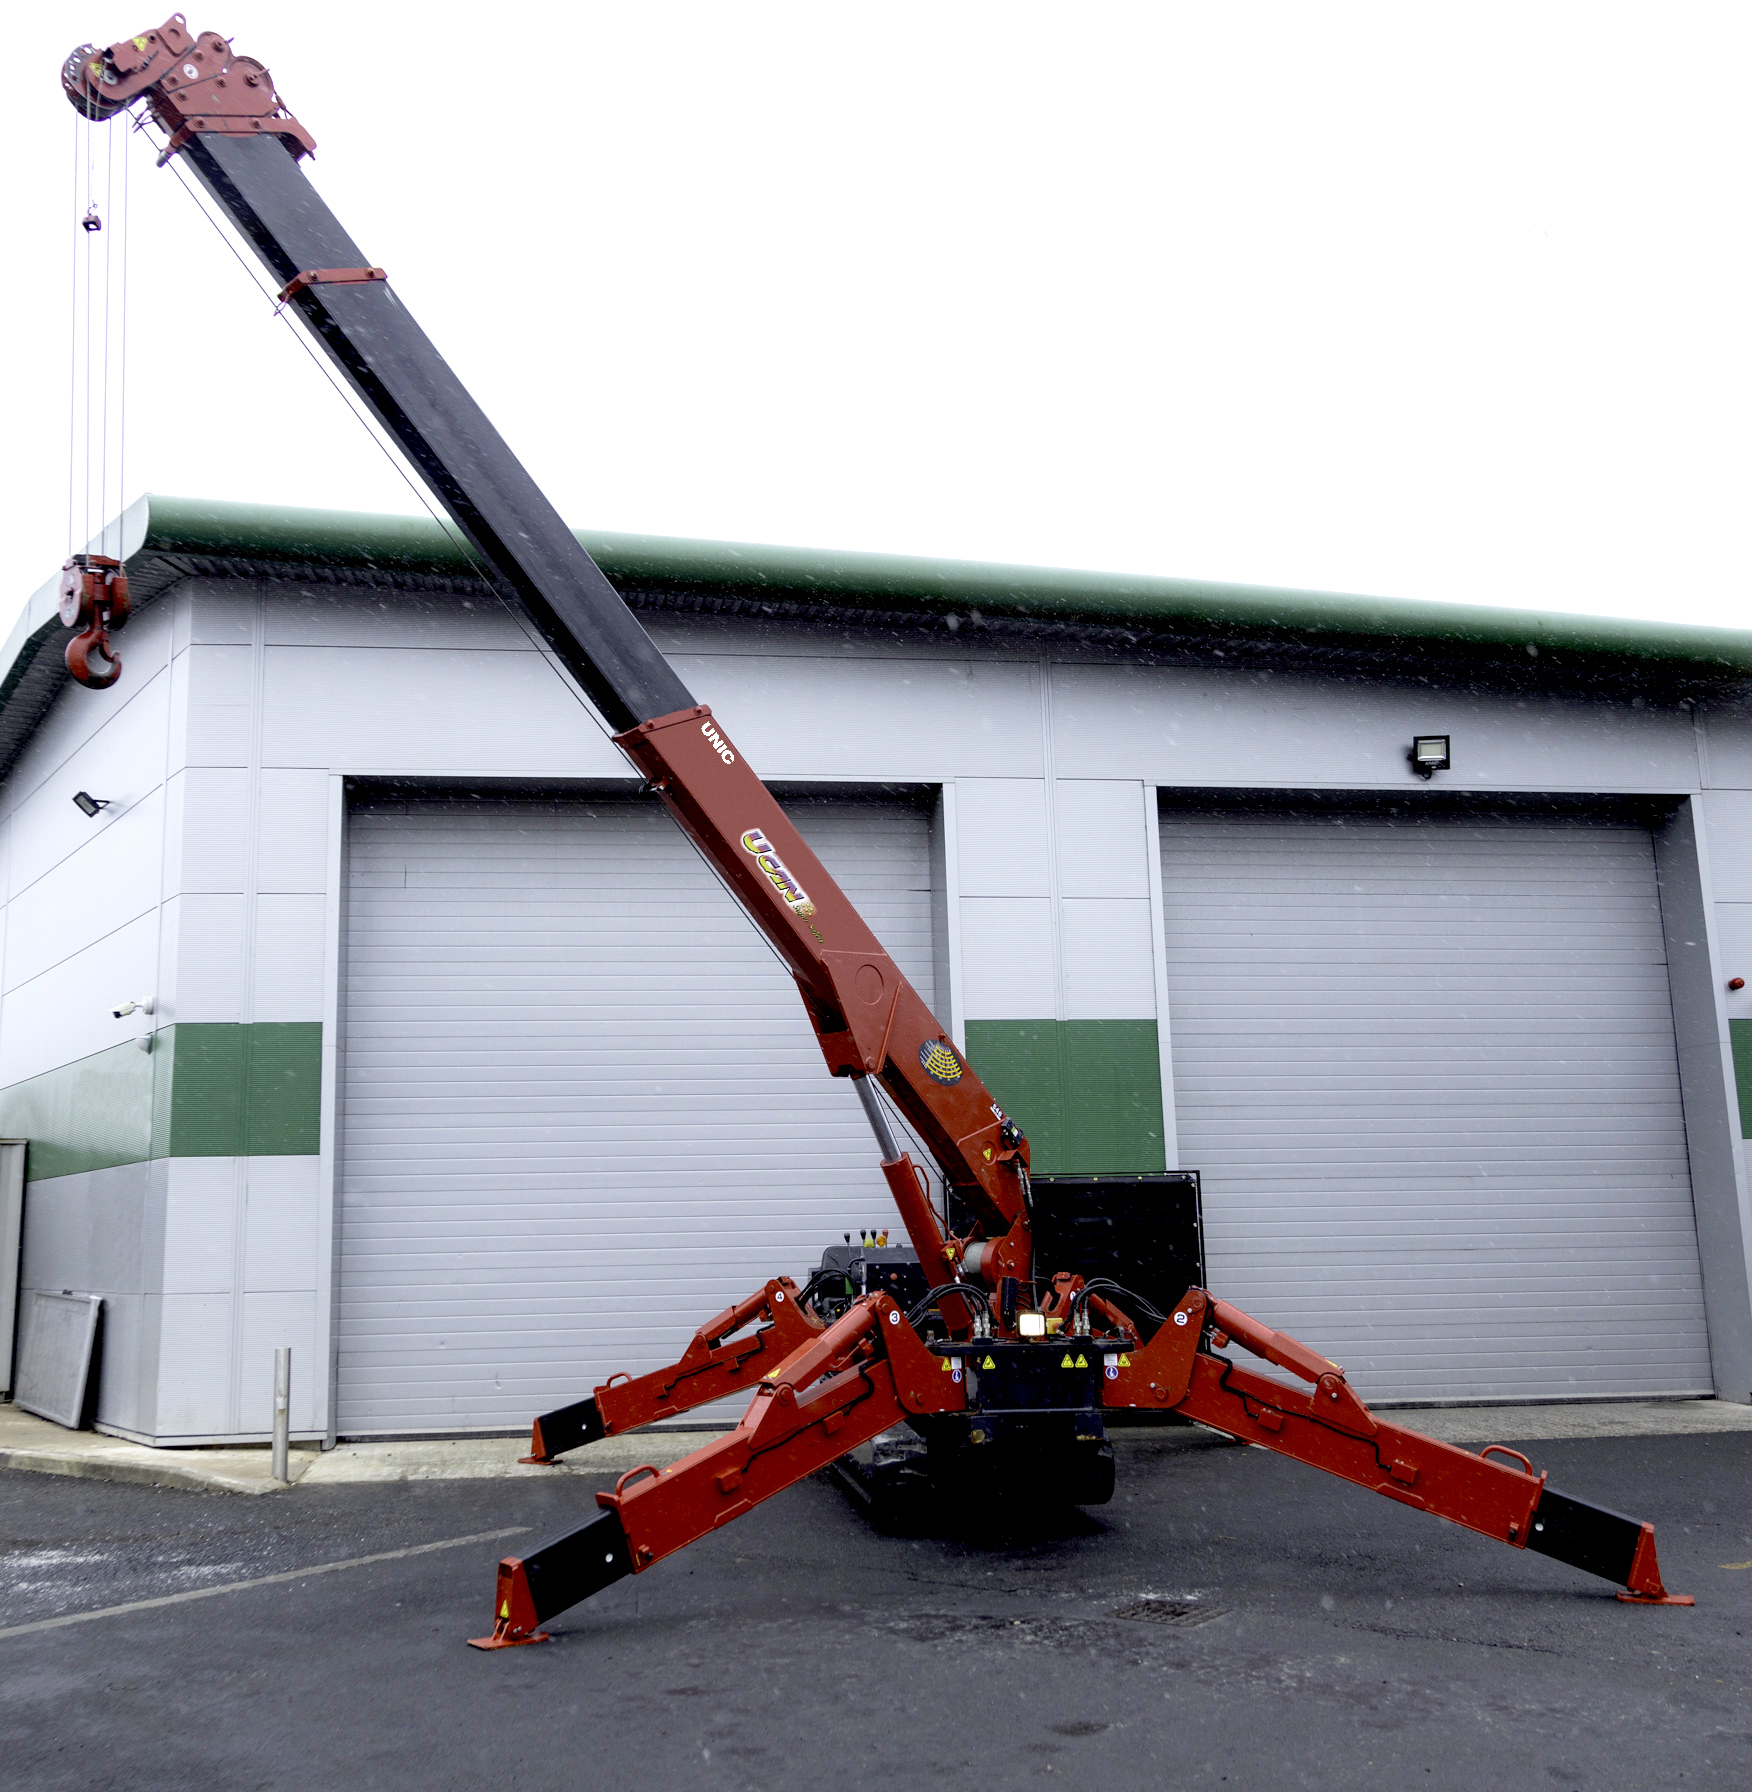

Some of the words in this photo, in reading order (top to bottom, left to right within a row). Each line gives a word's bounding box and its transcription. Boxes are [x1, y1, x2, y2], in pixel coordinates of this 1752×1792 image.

[701, 721, 734, 764] UNIC
[742, 829, 806, 904] UCAN
[890, 1311, 899, 1323] 3
[1175, 1313, 1186, 1324] 2
